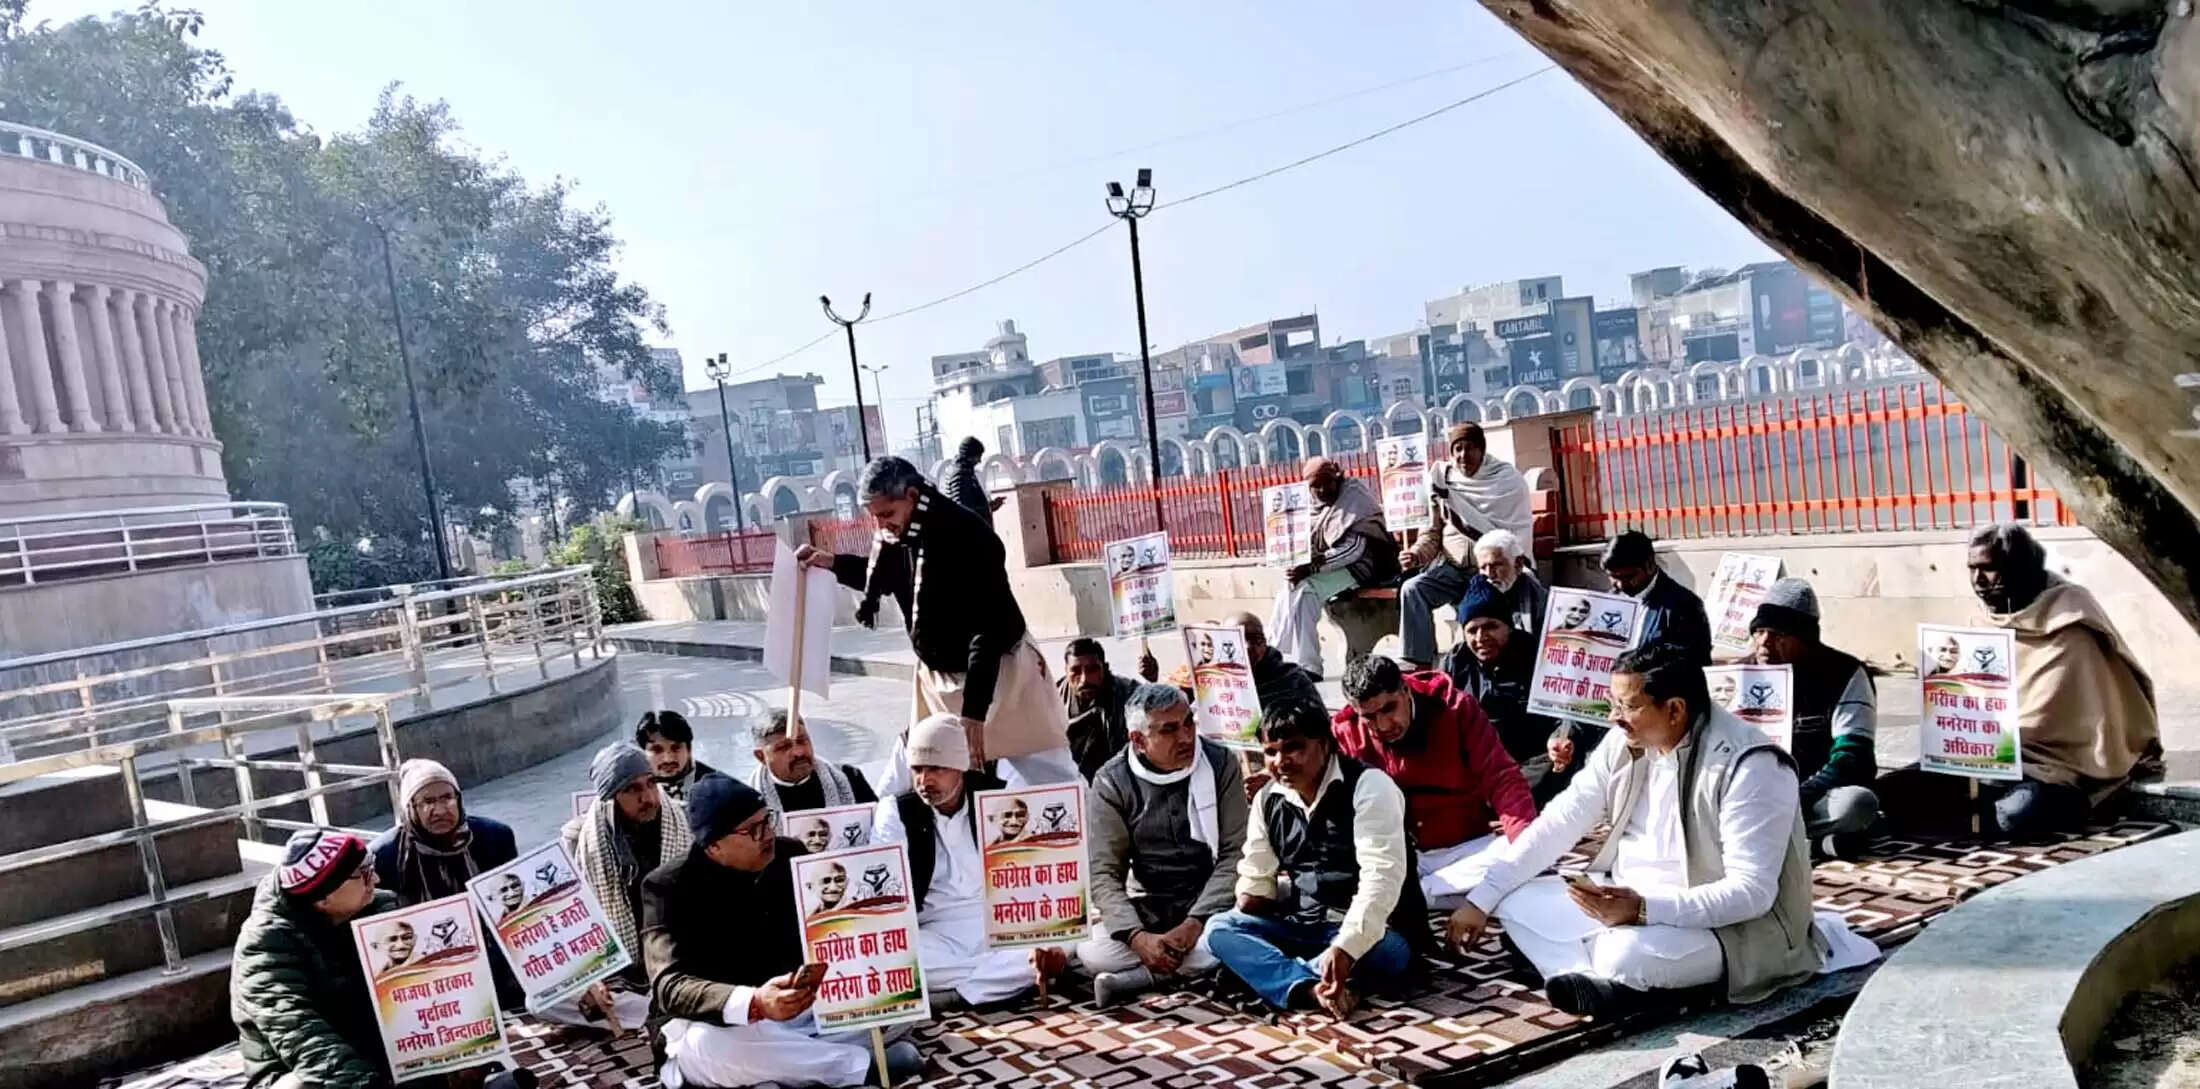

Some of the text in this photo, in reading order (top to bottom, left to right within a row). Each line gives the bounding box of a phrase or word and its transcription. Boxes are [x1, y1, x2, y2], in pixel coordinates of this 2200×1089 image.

[1571, 646, 1586, 669] की
[1587, 654, 1615, 673] आवा
[1576, 677, 1590, 697] की
[1929, 689, 1958, 709] गरीब
[1936, 713, 1977, 734] मनरेगा
[1943, 735, 1997, 757] अधिकार
[991, 861, 1078, 889] कांग्रेस का हाथ
[992, 893, 1081, 924] मनरेगा के साथ
[510, 923, 551, 950] मनरेगा
[522, 952, 554, 979] गरीब
[553, 942, 571, 966] की
[568, 922, 609, 956] मजबूरी
[814, 928, 907, 962] कांग्रेस का हाथ
[392, 972, 475, 1004] भाजपा सरकार
[820, 966, 914, 1003] मनरेगा के साथ
[416, 1000, 462, 1030] मुर्दाबाद
[395, 1016, 494, 1053] मनरेगा जिन्दाबाद
